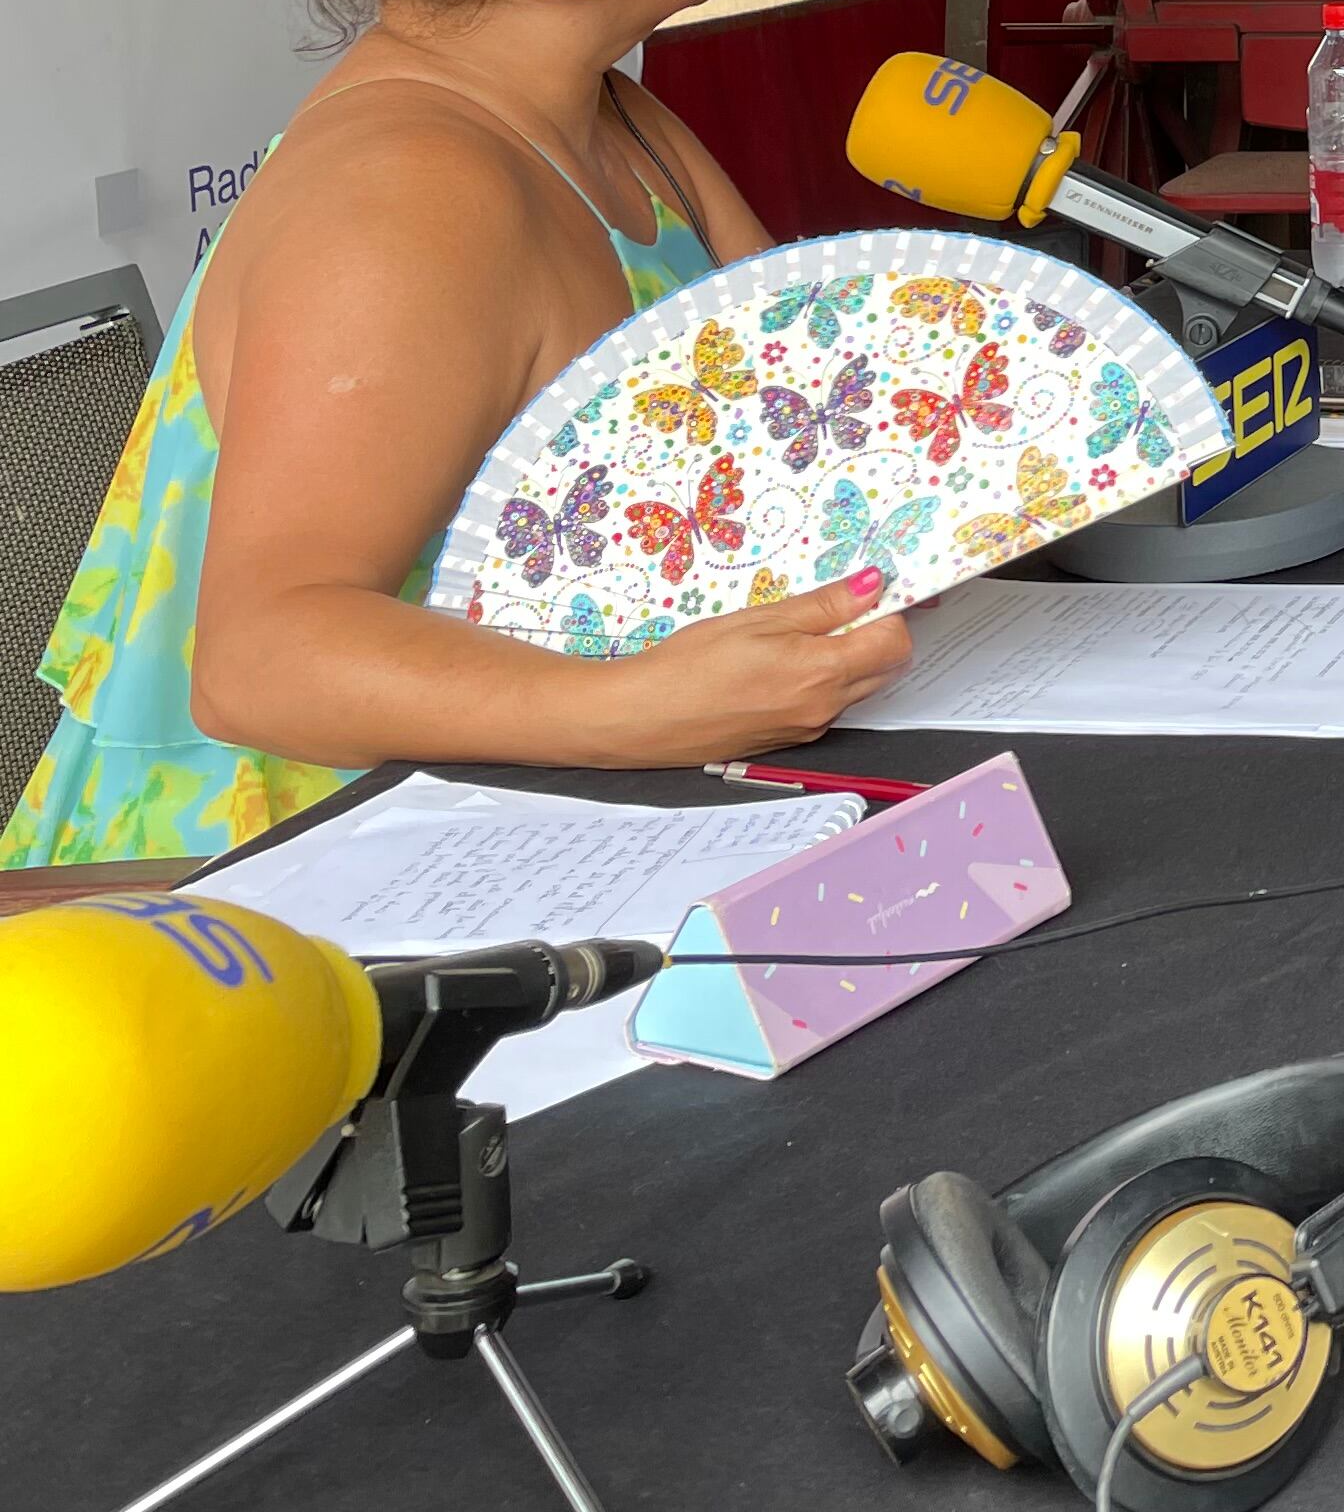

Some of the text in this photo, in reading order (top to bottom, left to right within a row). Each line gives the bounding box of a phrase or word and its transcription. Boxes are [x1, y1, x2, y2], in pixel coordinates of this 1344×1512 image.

[189, 147, 268, 213] Rad
[1083, 198, 1154, 234] SENNHEISER
[1223, 1307, 1259, 1377] Monitor
[1241, 1290, 1283, 1368] K141
